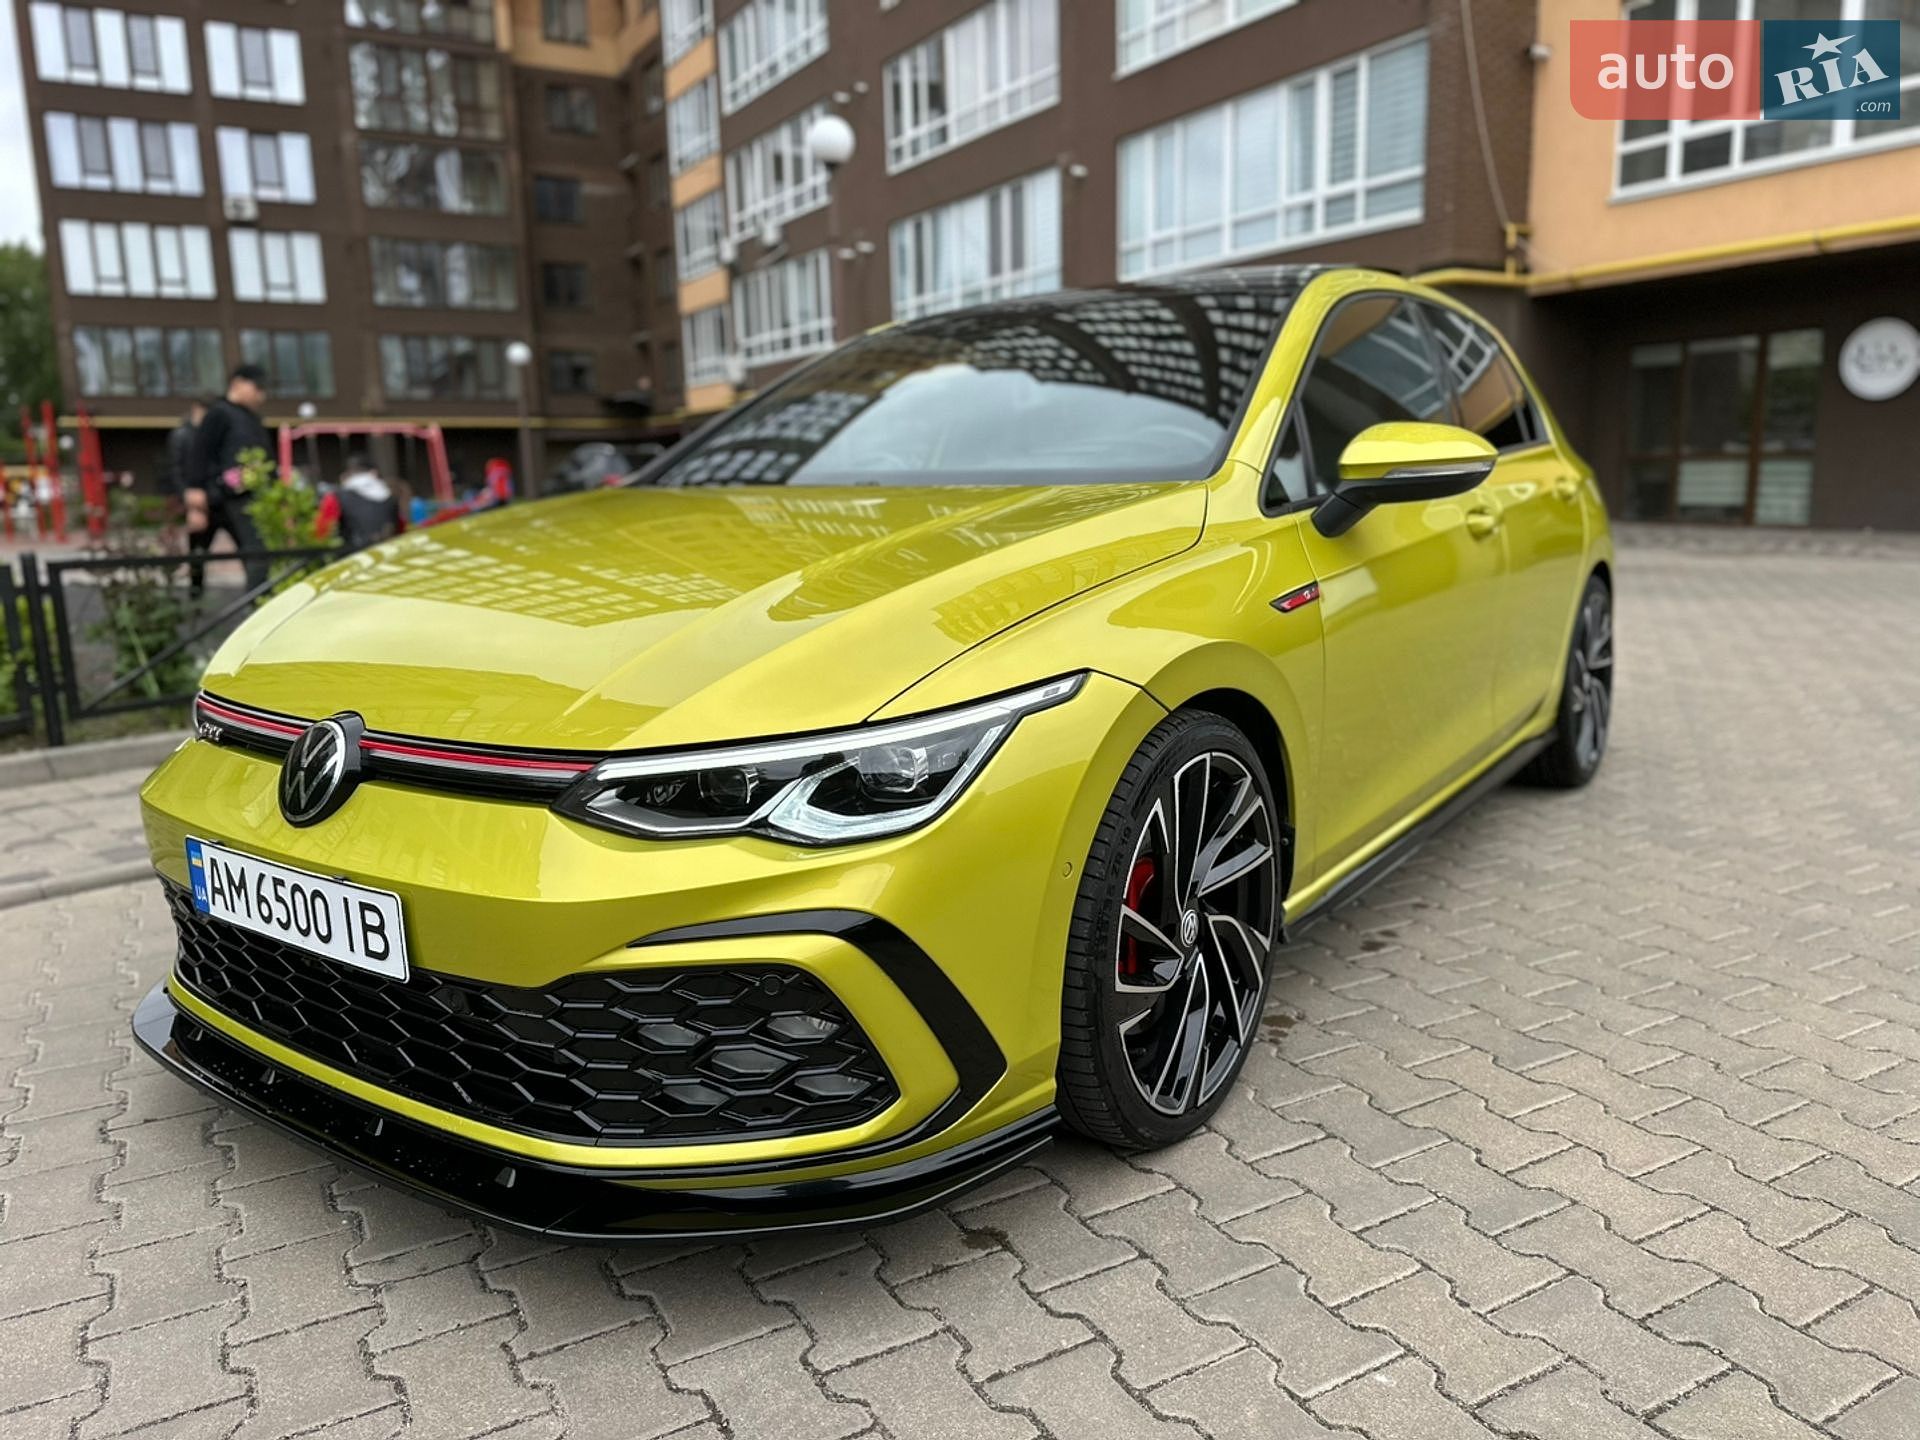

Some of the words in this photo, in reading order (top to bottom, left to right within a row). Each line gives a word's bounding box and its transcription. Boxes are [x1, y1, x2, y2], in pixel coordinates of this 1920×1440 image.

[194, 884, 208, 903] UA
[209, 857, 252, 919] AM
[256, 872, 332, 944] 6500
[343, 896, 390, 961] IB
